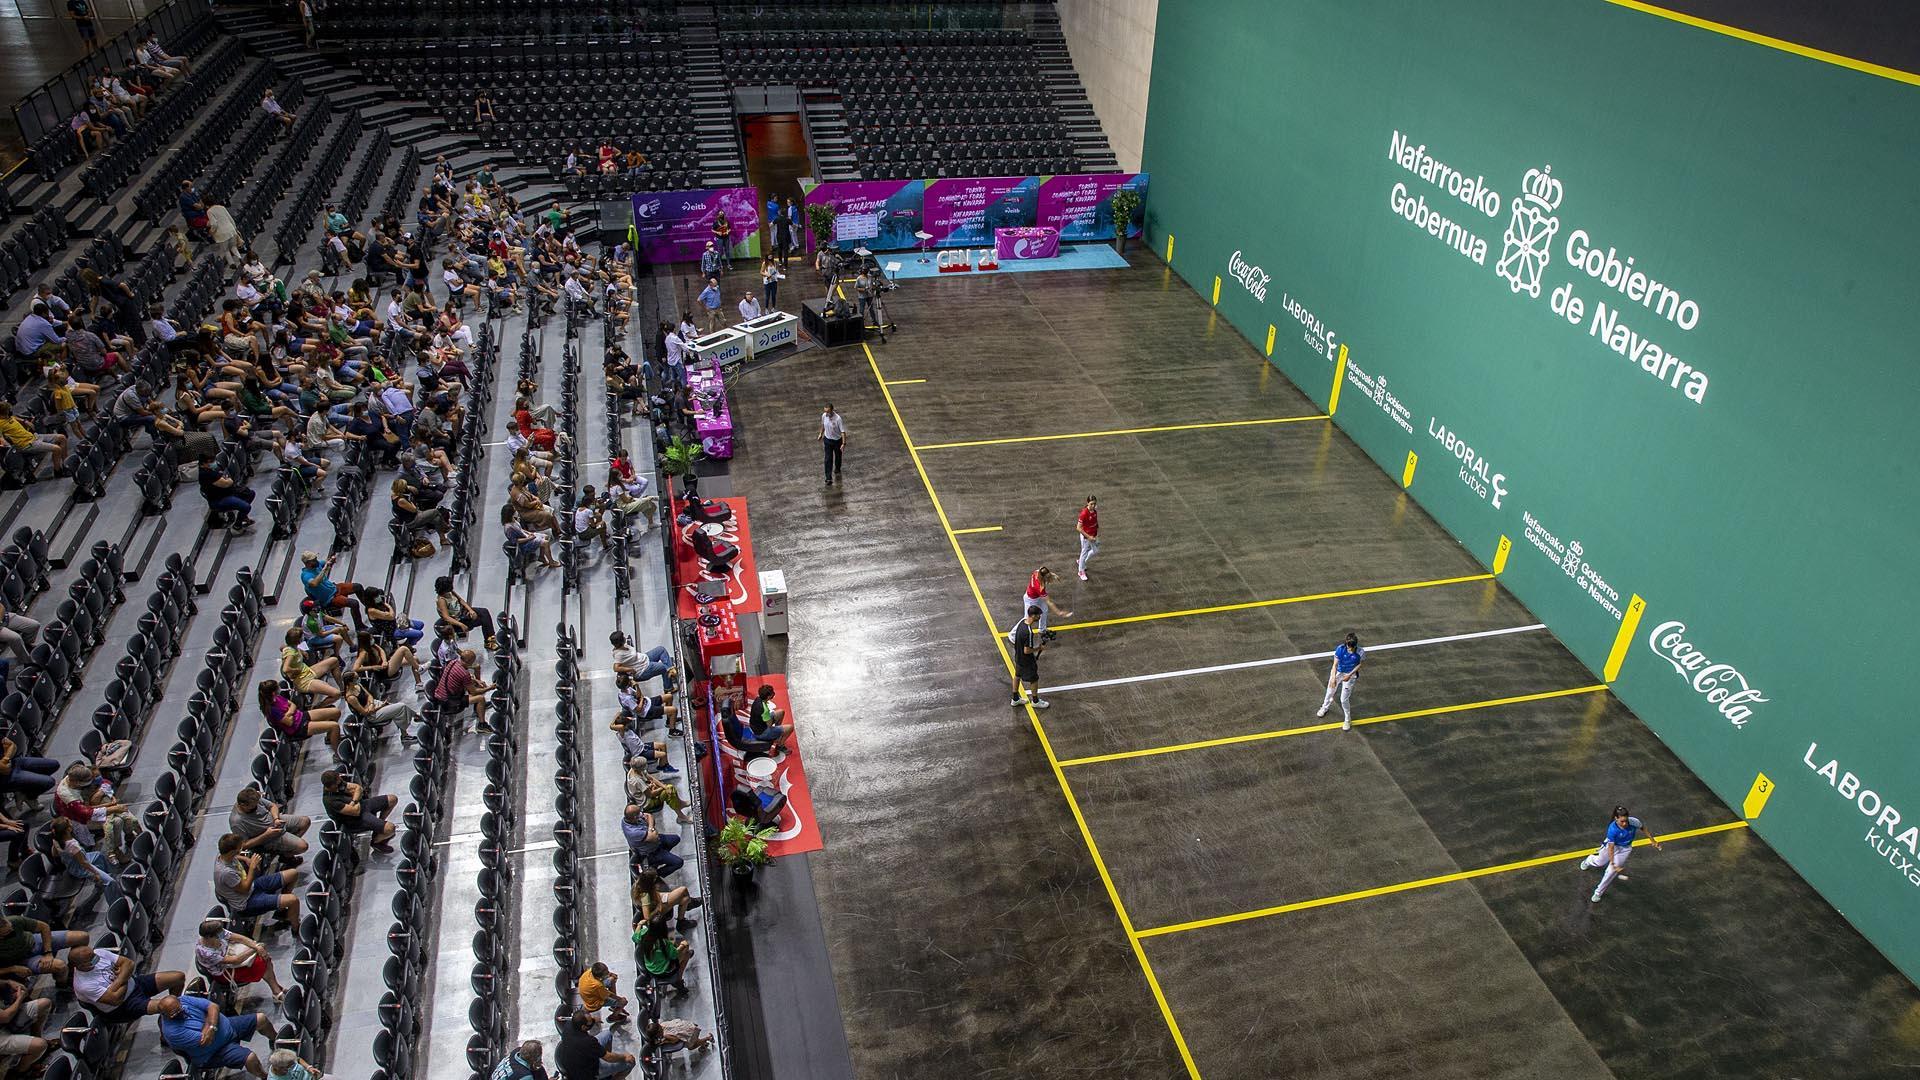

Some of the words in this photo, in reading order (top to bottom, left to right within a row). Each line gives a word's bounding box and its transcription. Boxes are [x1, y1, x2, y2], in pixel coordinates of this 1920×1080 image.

[1388, 130, 1500, 218] Nafarroako
[1390, 182, 1488, 266] Gobernua
[937, 248, 971, 268] CFN
[1228, 250, 1271, 304] Coca-Cola
[1565, 229, 1700, 331] Gobierno
[770, 327, 791, 343] eitb
[1282, 292, 1325, 342] LABORAL
[719, 345, 740, 360] eitb
[1303, 329, 1324, 355] kutxa
[1550, 282, 1585, 325] de
[1589, 301, 1709, 405] Navarra
[1346, 358, 1375, 388] Nafarroako
[1347, 371, 1373, 398] Gobernua
[1382, 403, 1391, 414] de
[1390, 408, 1414, 435] Navarra
[1385, 391, 1411, 419] Gobierno
[1410, 456, 1415, 465] 6
[1428, 416, 1490, 484] LABORAL
[1458, 466, 1487, 499] kutxa
[1501, 540, 1507, 551] 5
[1522, 510, 1565, 554] Nafarroako
[1524, 527, 1561, 565] Gobernua
[1576, 576, 1588, 590] de
[1587, 584, 1622, 621] Navarra
[1581, 562, 1619, 602] Gobierno
[1632, 601, 1642, 613] 4
[1648, 620, 1771, 730] Coca-Cola
[1758, 780, 1768, 793] 3
[1803, 741, 1920, 862] LABORA
[1864, 826, 1920, 887] kutxa
